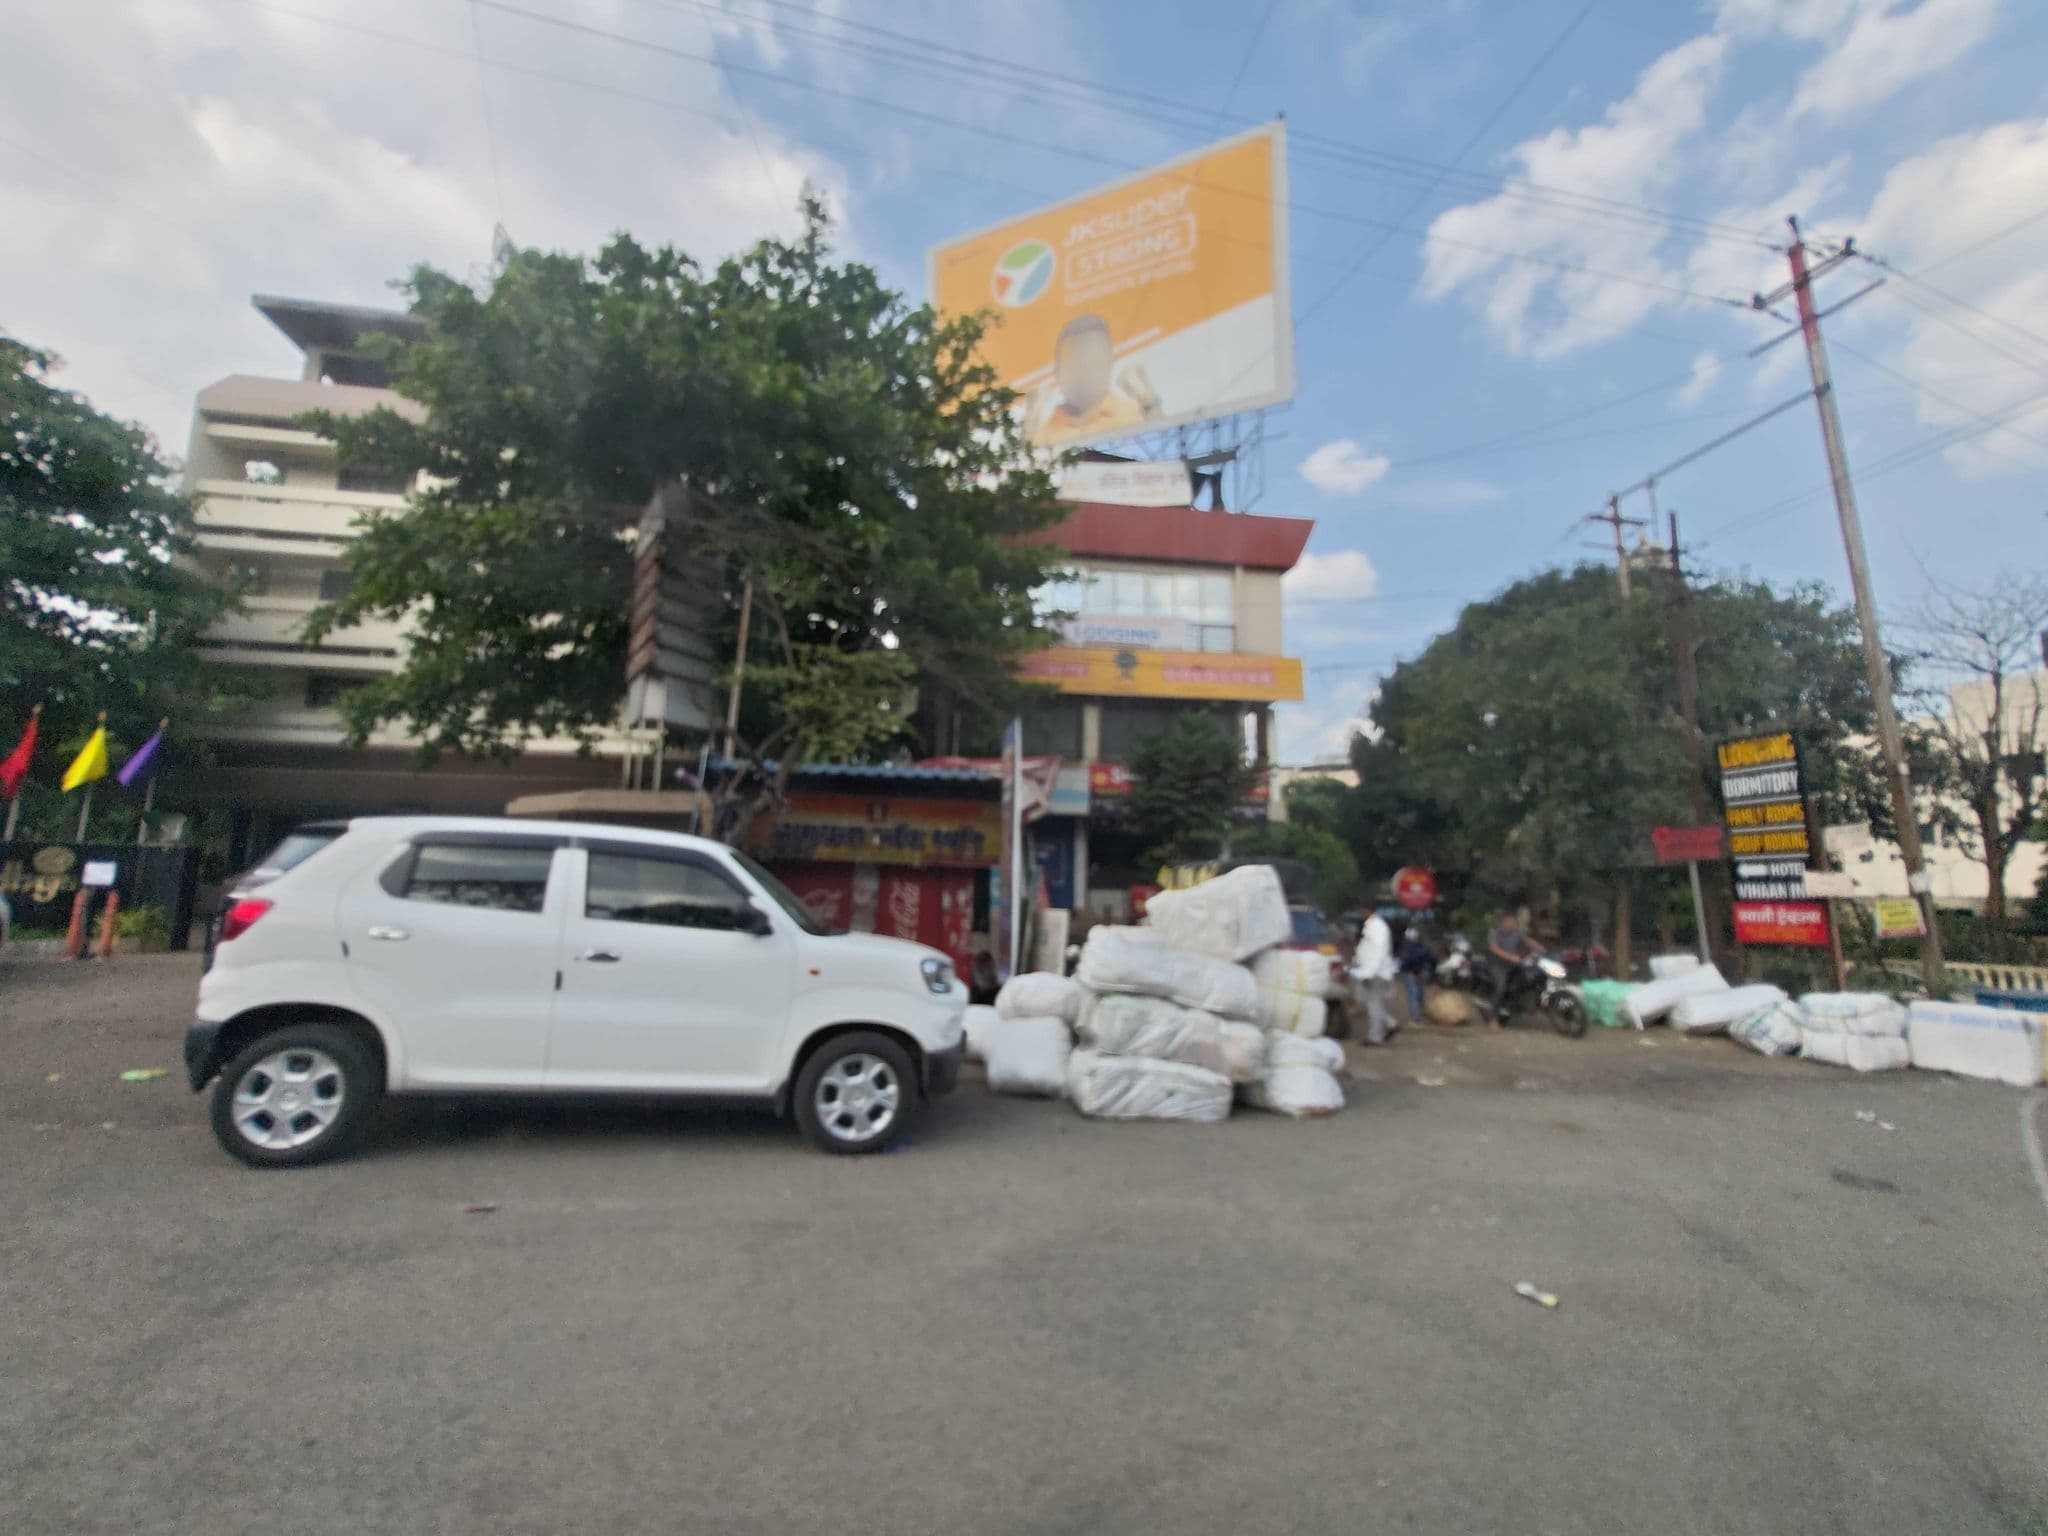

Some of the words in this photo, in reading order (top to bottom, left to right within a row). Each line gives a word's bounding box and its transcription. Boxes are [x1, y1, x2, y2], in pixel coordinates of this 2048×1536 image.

[1079, 228, 1180, 274] STRONG
[1722, 771, 1798, 797] DORMITORY
[1766, 802, 1804, 823] ROOMS
[1771, 862, 1806, 877] HOTEL
[1736, 880, 1787, 900] VIHAAN
